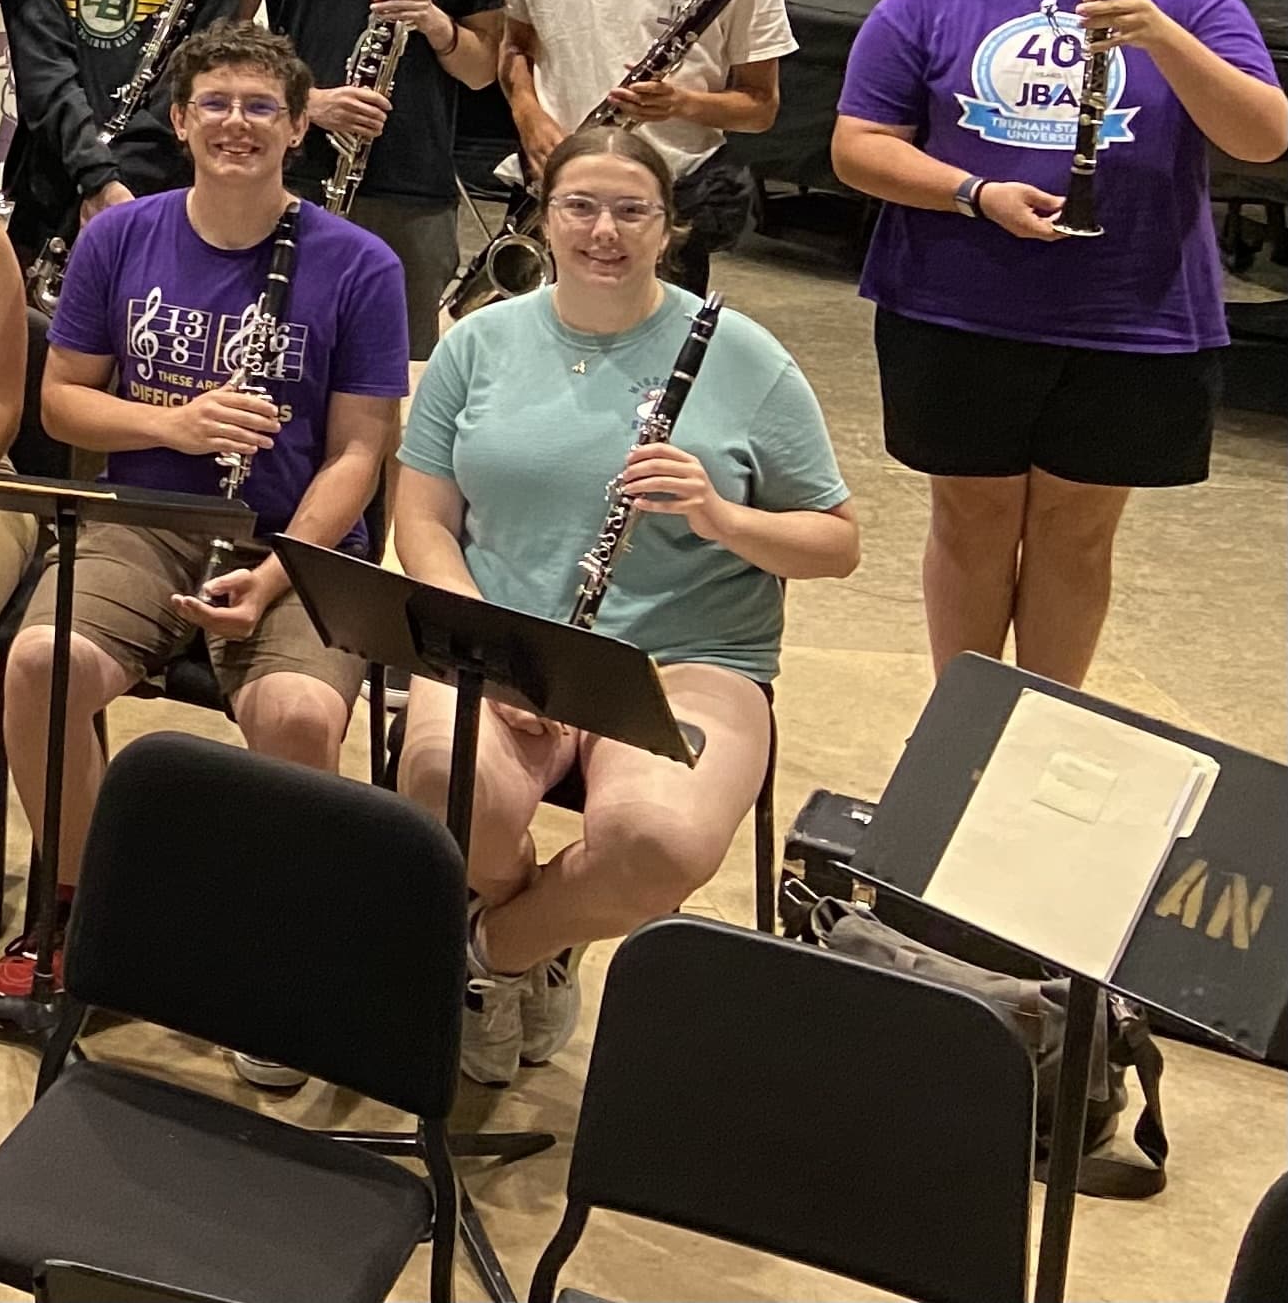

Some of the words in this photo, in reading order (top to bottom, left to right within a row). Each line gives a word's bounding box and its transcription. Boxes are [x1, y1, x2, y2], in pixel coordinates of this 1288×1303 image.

[1016, 34, 1084, 68] 40
[992, 116, 1051, 134] TRUMAN
[1055, 123, 1078, 134] STA
[1006, 129, 1077, 143] UNIVERSIT
[165, 309, 204, 339] 13
[171, 336, 190, 364] 8
[157, 370, 194, 388] THESE
[130, 381, 189, 408] DIFFIC
